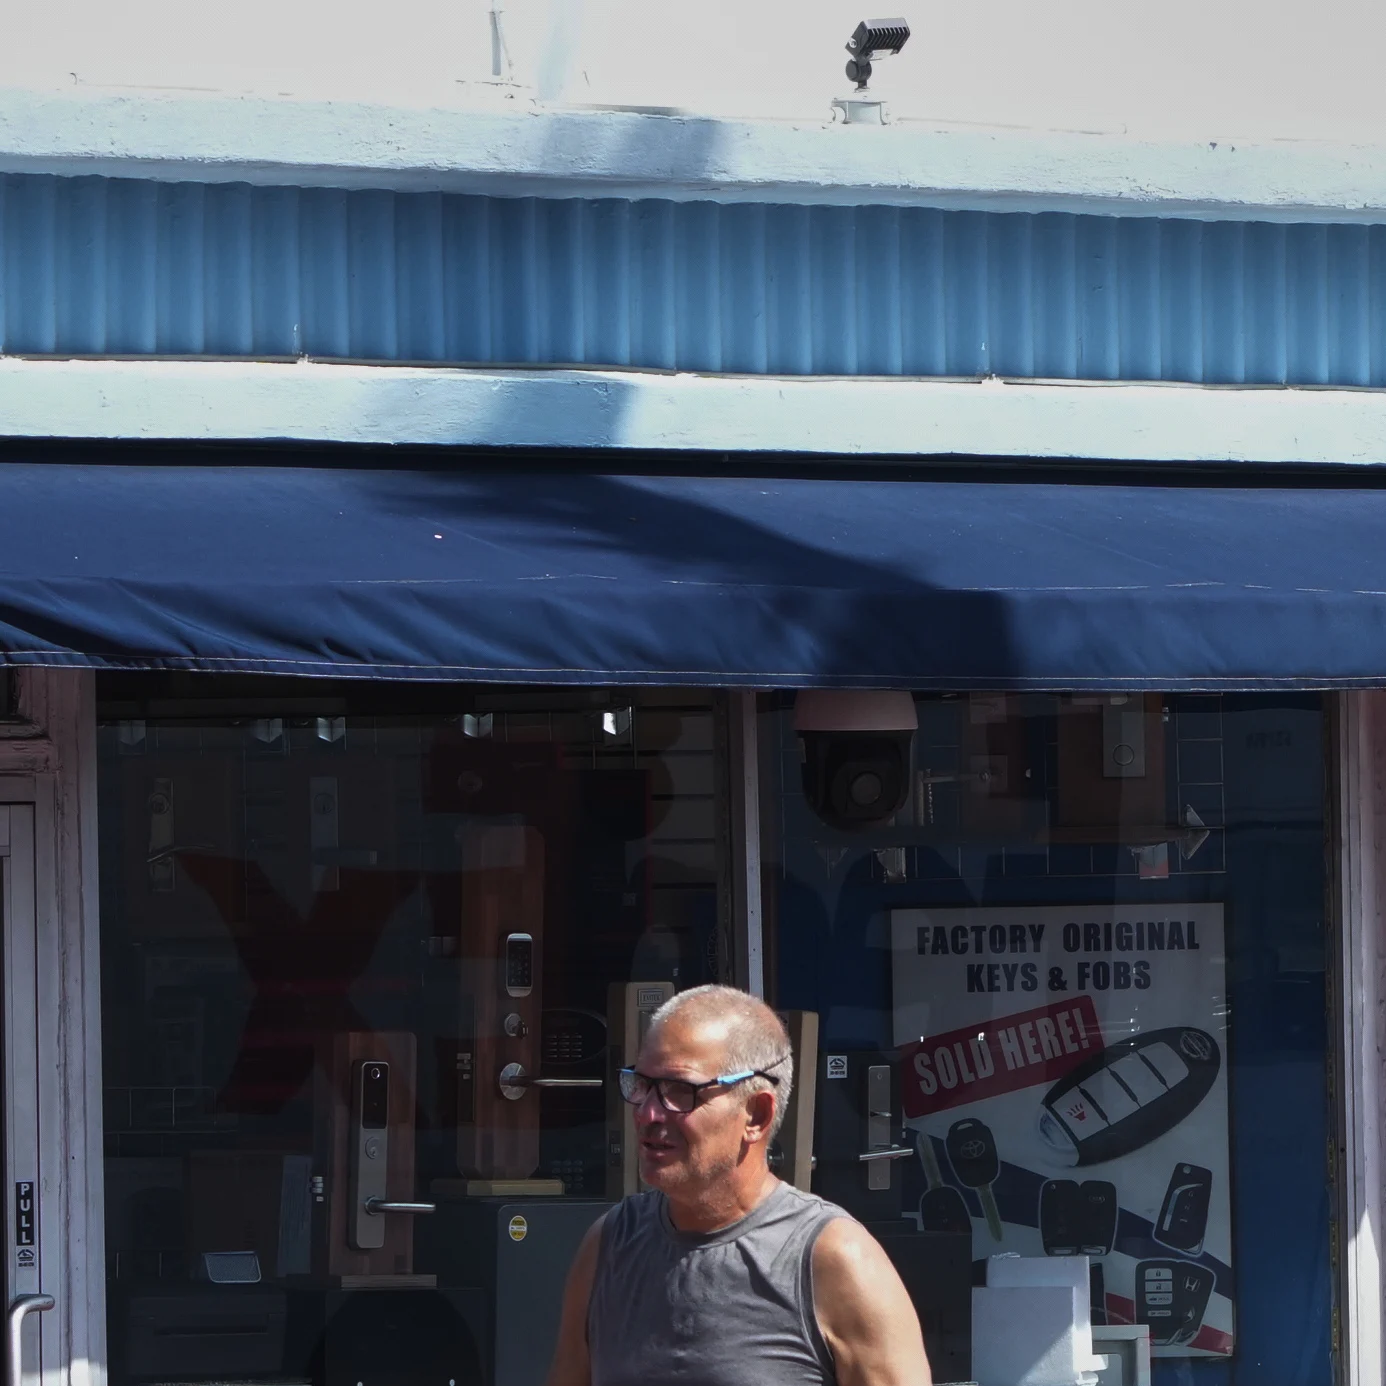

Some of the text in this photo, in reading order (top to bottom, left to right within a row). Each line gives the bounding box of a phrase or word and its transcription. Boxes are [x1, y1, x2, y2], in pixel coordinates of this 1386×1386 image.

[916, 921, 1200, 955] FACTORY ORIGINAL
[966, 960, 1151, 993] KEYS & FOBS
[913, 1007, 1091, 1095] SOLD HERE!
[20, 1183, 31, 1244] PULL
